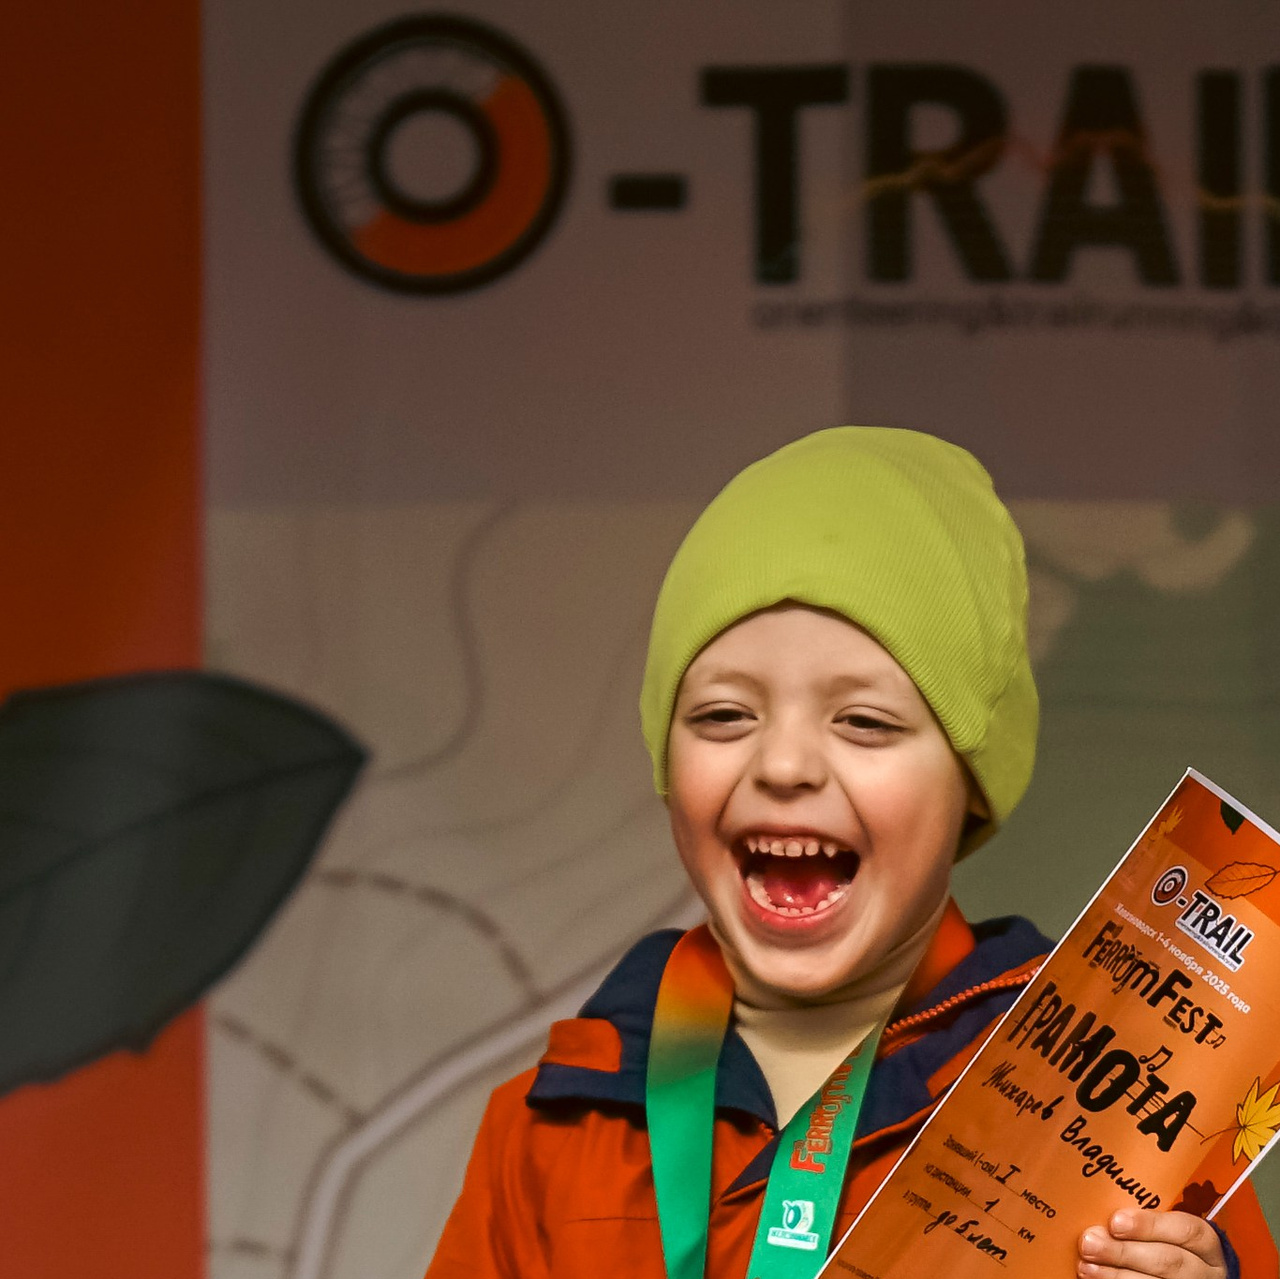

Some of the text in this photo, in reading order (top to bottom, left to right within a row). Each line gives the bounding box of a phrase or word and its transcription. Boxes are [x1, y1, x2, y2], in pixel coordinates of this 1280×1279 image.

[1168, 944, 1204, 975] ноября
[1202, 970, 1230, 1000] 2025
[1226, 992, 1251, 1014] года
[1007, 980, 1198, 1153] ГРАМОТА
[1060, 1115, 1161, 1210] Владимир
[954, 1220, 979, 1234] 5
[984, 1198, 1000, 1213] 1
[1017, 1226, 1036, 1243] км
[1021, 1189, 1056, 1219] место
